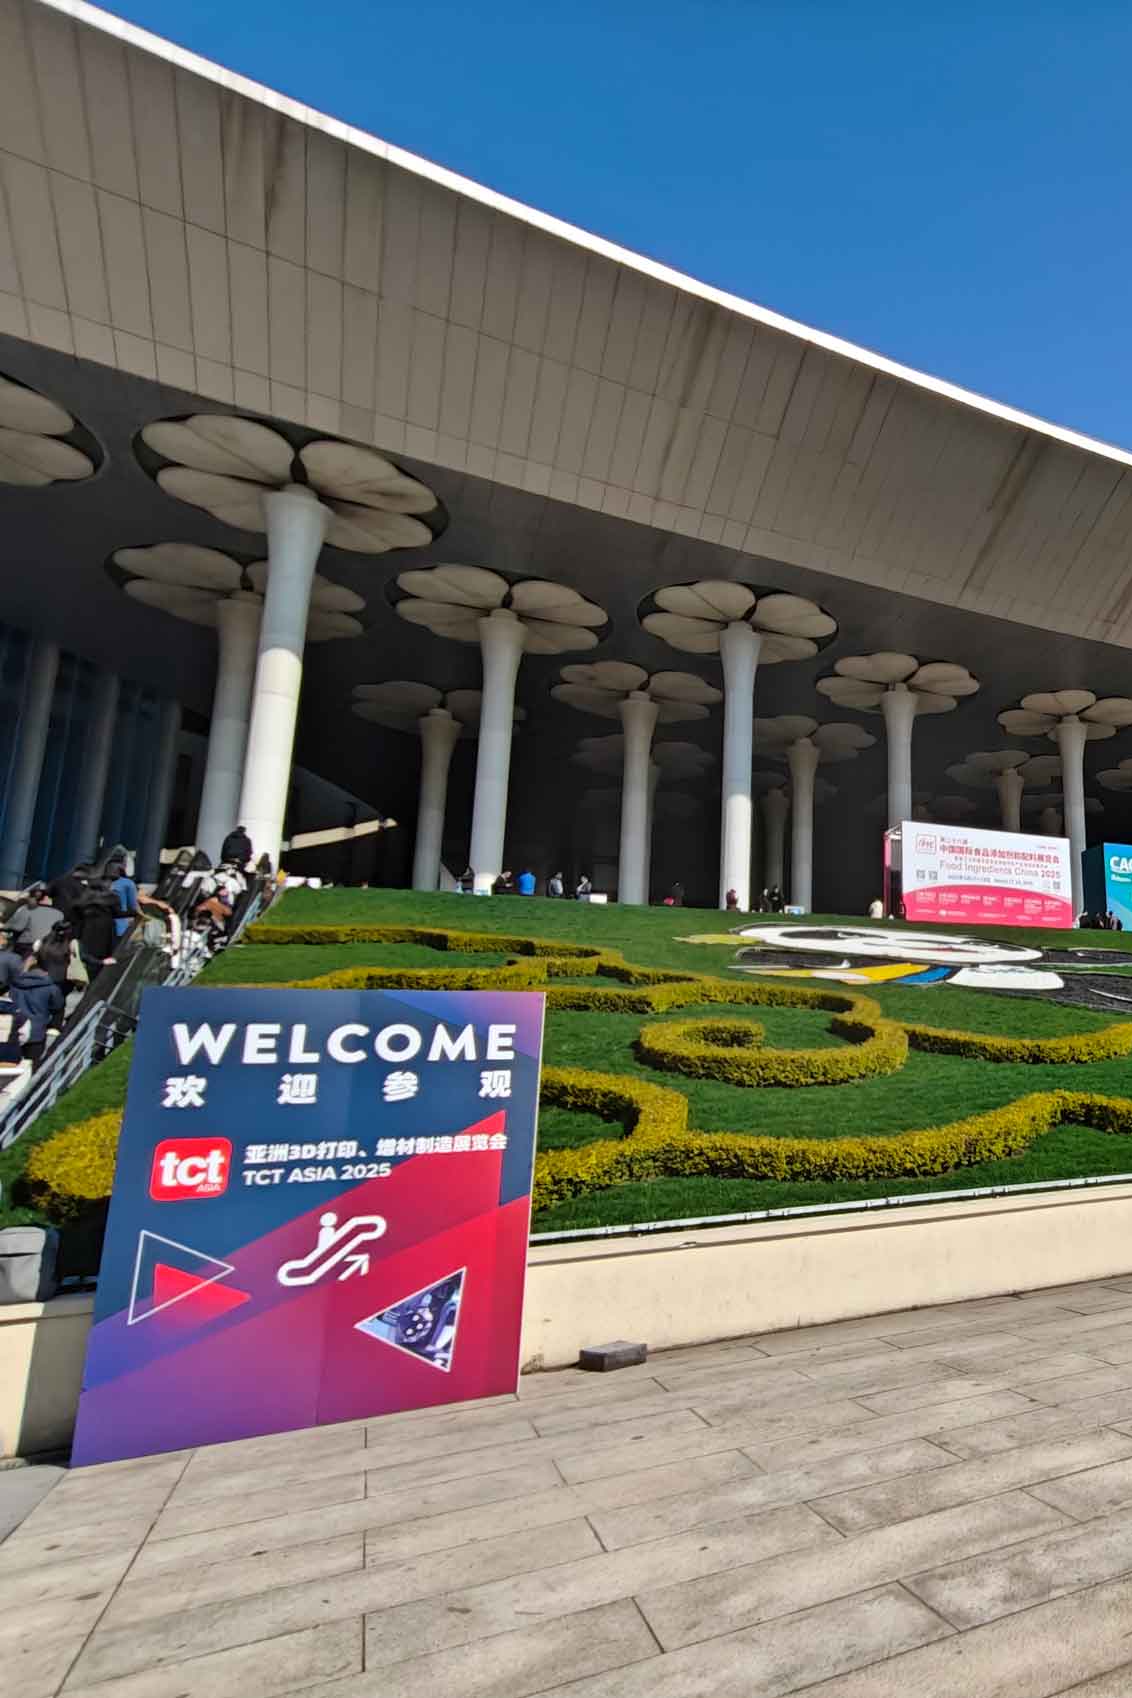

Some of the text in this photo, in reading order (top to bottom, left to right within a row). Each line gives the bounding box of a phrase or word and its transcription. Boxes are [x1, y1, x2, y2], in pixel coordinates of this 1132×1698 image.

[940, 860, 962, 871] Food
[965, 862, 1013, 875] Ingredients
[172, 1022, 517, 1066] WELCOME
[162, 1070, 513, 1108] 欢迎参观
[159, 1150, 225, 1188] tct
[243, 1162, 393, 1186] TCT ASIA 2025
